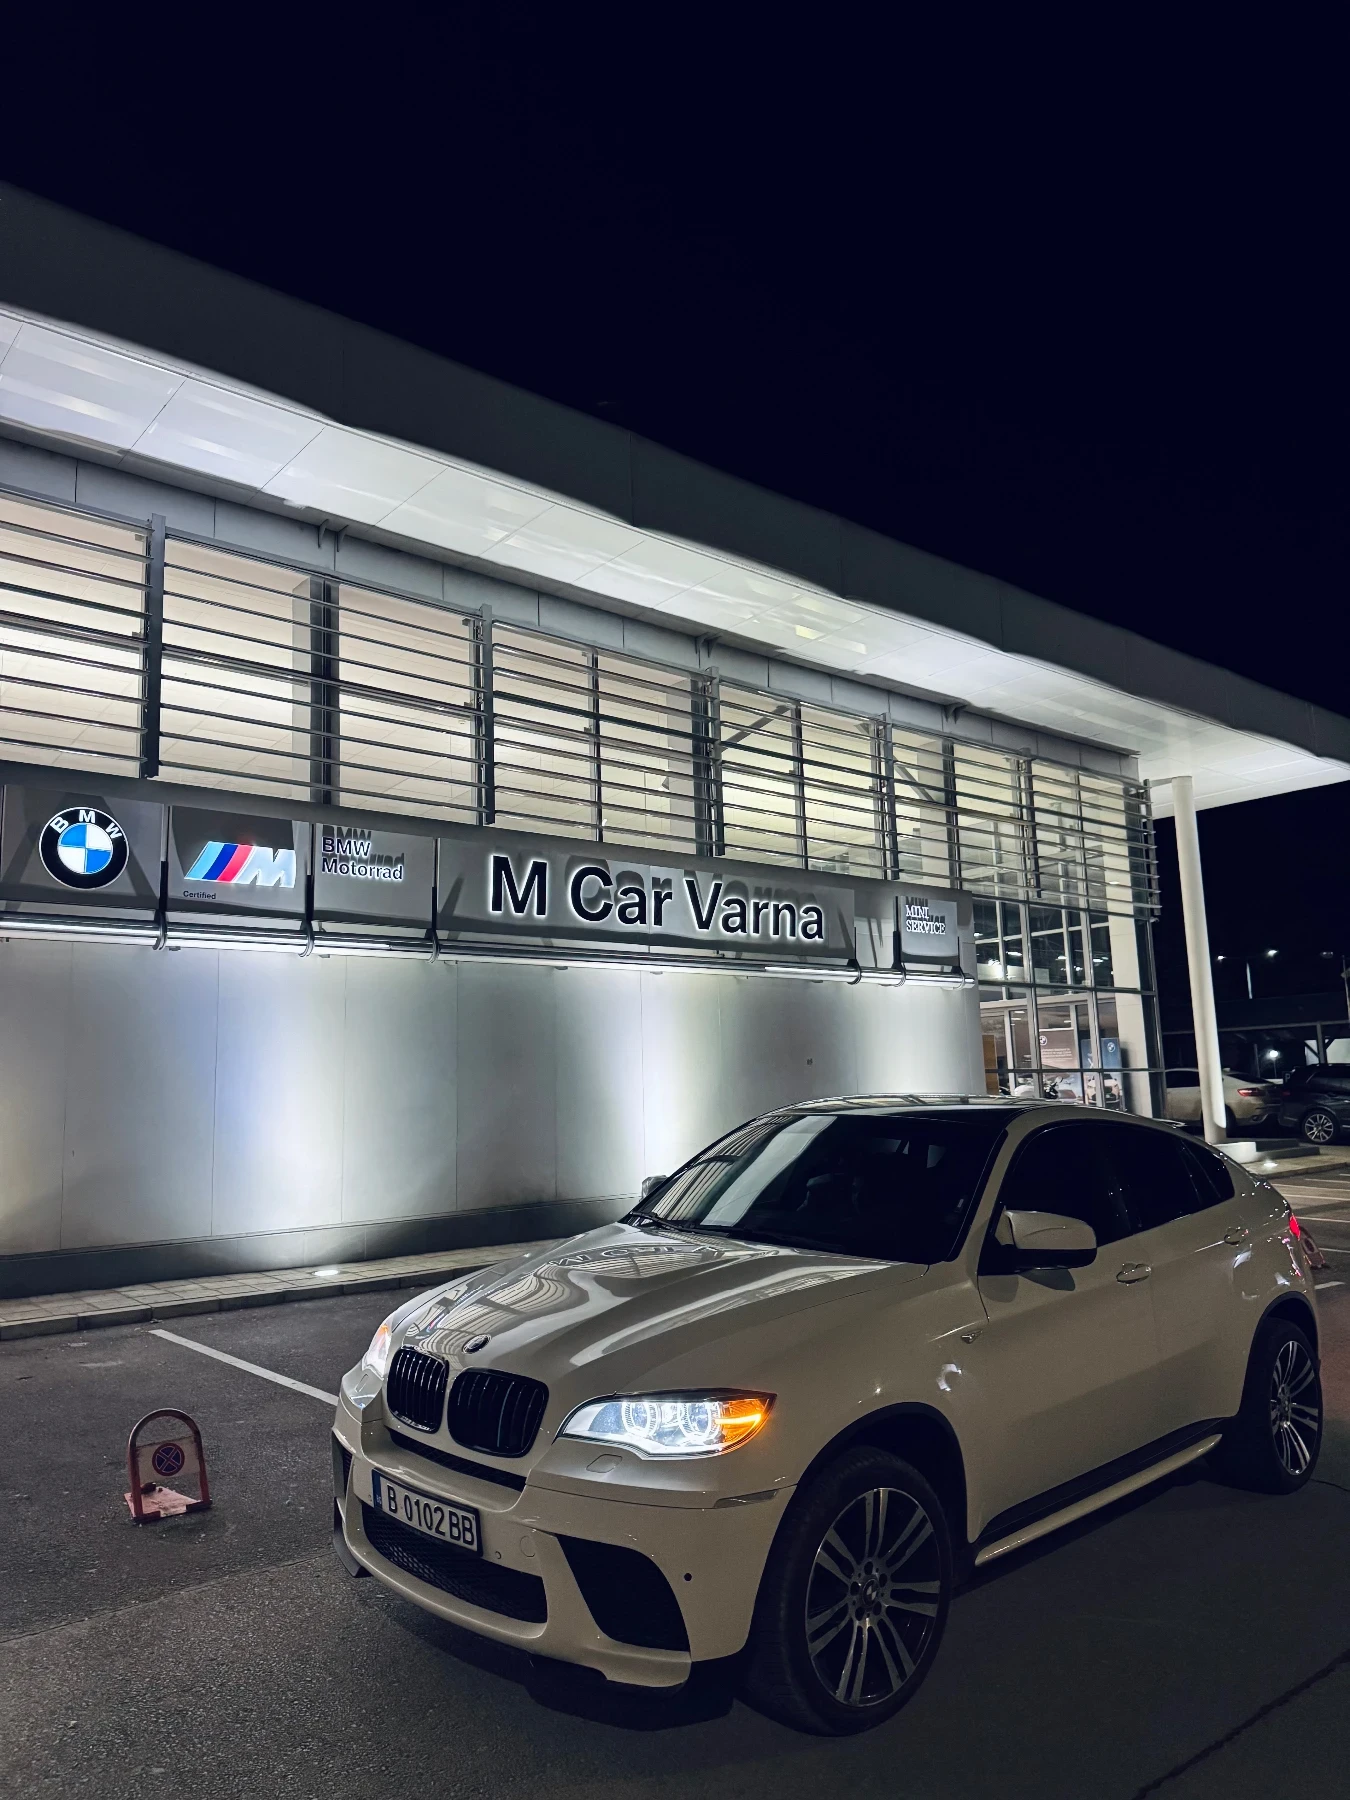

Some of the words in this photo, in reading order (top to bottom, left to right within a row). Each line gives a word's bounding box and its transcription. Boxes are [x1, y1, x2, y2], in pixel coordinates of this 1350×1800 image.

[50, 809, 123, 840] BMW
[322, 837, 371, 857] BMW
[322, 858, 404, 881] Motorrad
[183, 890, 217, 900] Certified
[491, 856, 549, 916] M
[570, 866, 673, 928] Car
[684, 878, 825, 941] Varna
[905, 905, 930, 919] MINI
[906, 919, 946, 935] SERVICE
[387, 1484, 398, 1514] B
[404, 1494, 446, 1537] 0102
[448, 1509, 475, 1546] BB
